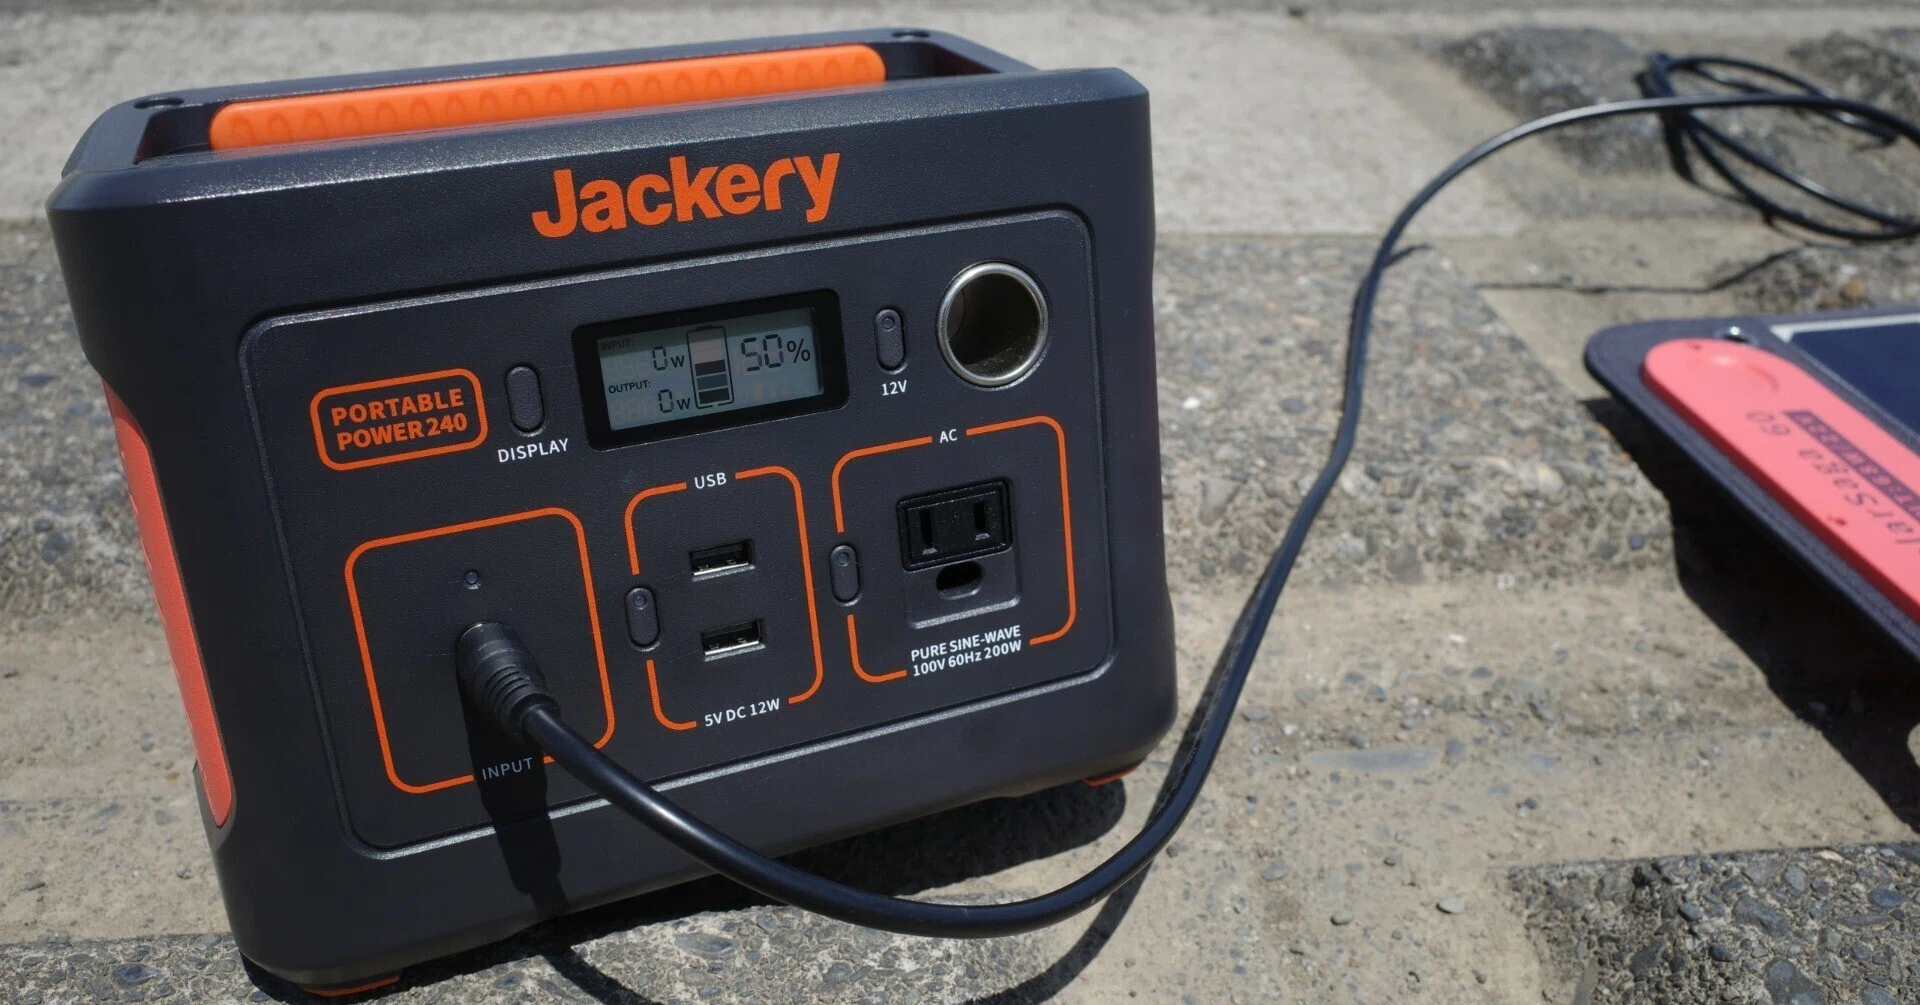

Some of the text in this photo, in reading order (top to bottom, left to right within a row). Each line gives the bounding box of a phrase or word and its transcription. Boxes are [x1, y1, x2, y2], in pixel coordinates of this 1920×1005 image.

[531, 152, 840, 238] Jackery
[601, 338, 634, 350] INPUT:
[741, 334, 811, 372] 50%
[608, 379, 651, 394] OUTPUT:
[881, 379, 907, 396] 12V
[331, 388, 464, 425] PORTABLE
[336, 412, 468, 450] POWER 240
[939, 428, 958, 444] AC
[497, 438, 569, 463] DISPLAY
[694, 472, 727, 490] USB
[911, 625, 1021, 662] PURE SINE-WAVE
[913, 639, 1022, 677] 100V 60Hz 200W
[704, 698, 780, 727] 5V DC 12W
[482, 757, 533, 780] INPUT
